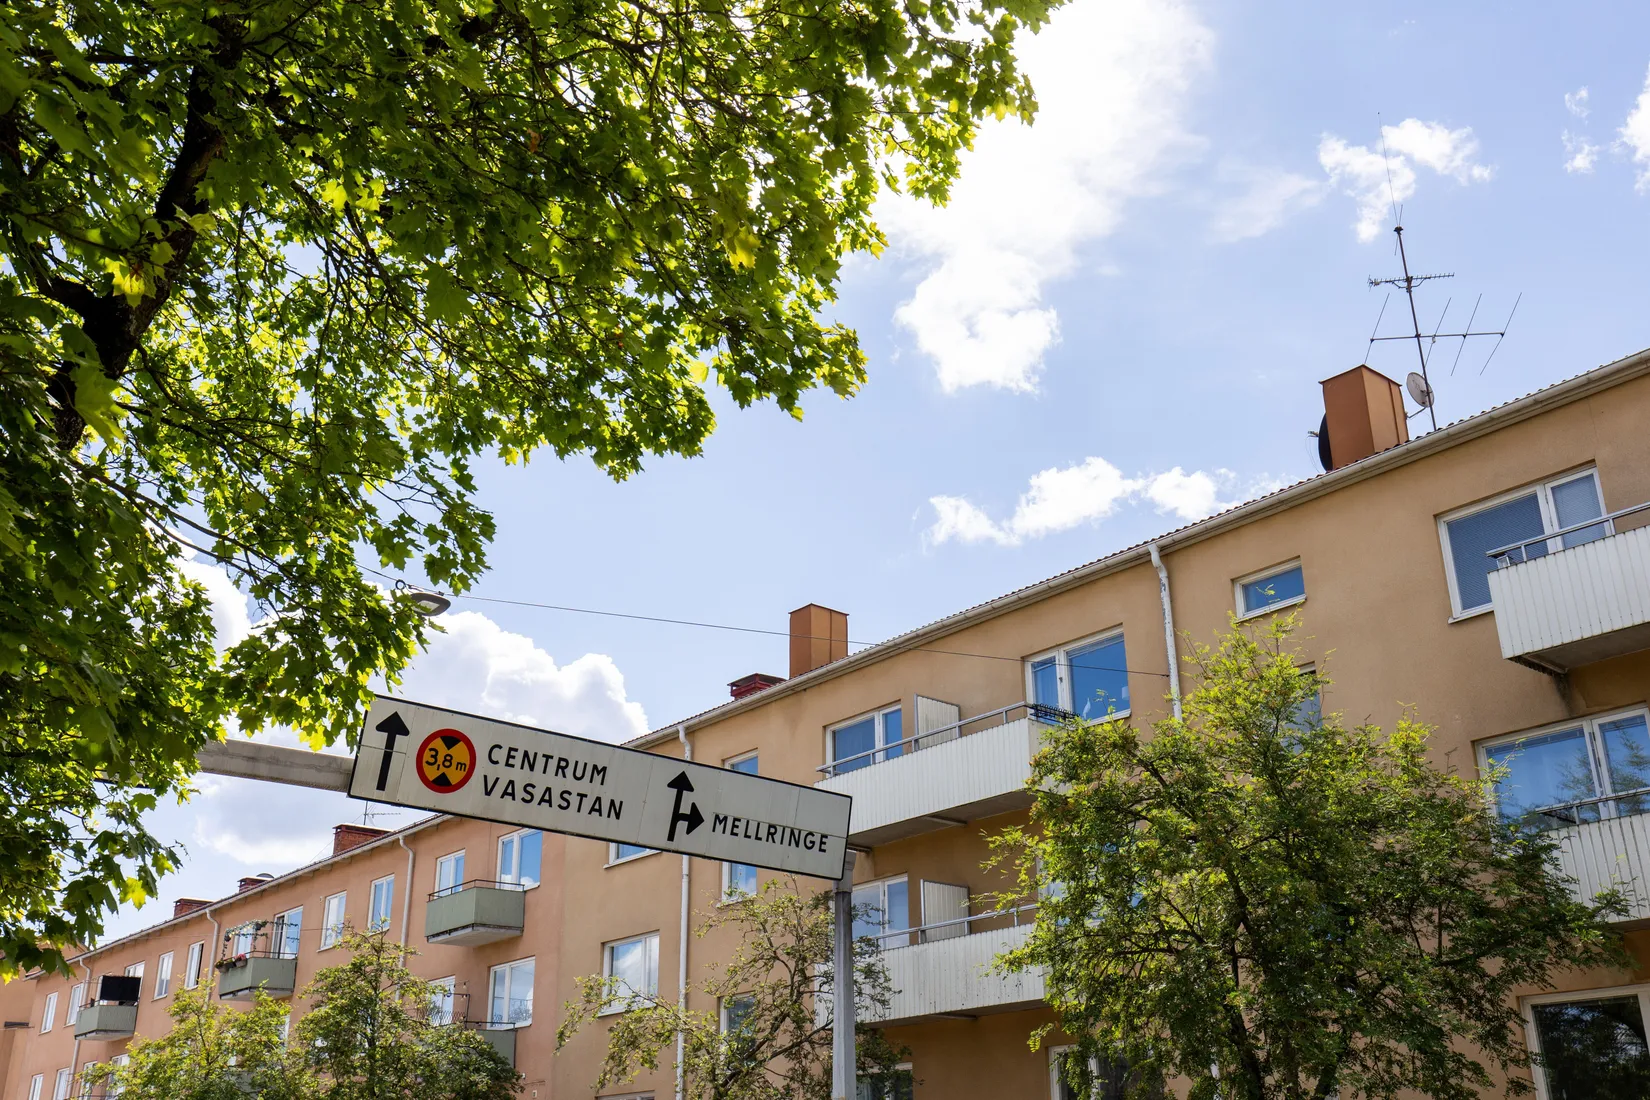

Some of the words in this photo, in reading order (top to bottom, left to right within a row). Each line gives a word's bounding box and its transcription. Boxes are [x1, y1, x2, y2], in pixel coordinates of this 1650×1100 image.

[487, 743, 608, 786] CENTRUM
[483, 774, 624, 821] VASASTAN
[711, 813, 829, 853] MELLRINGE
